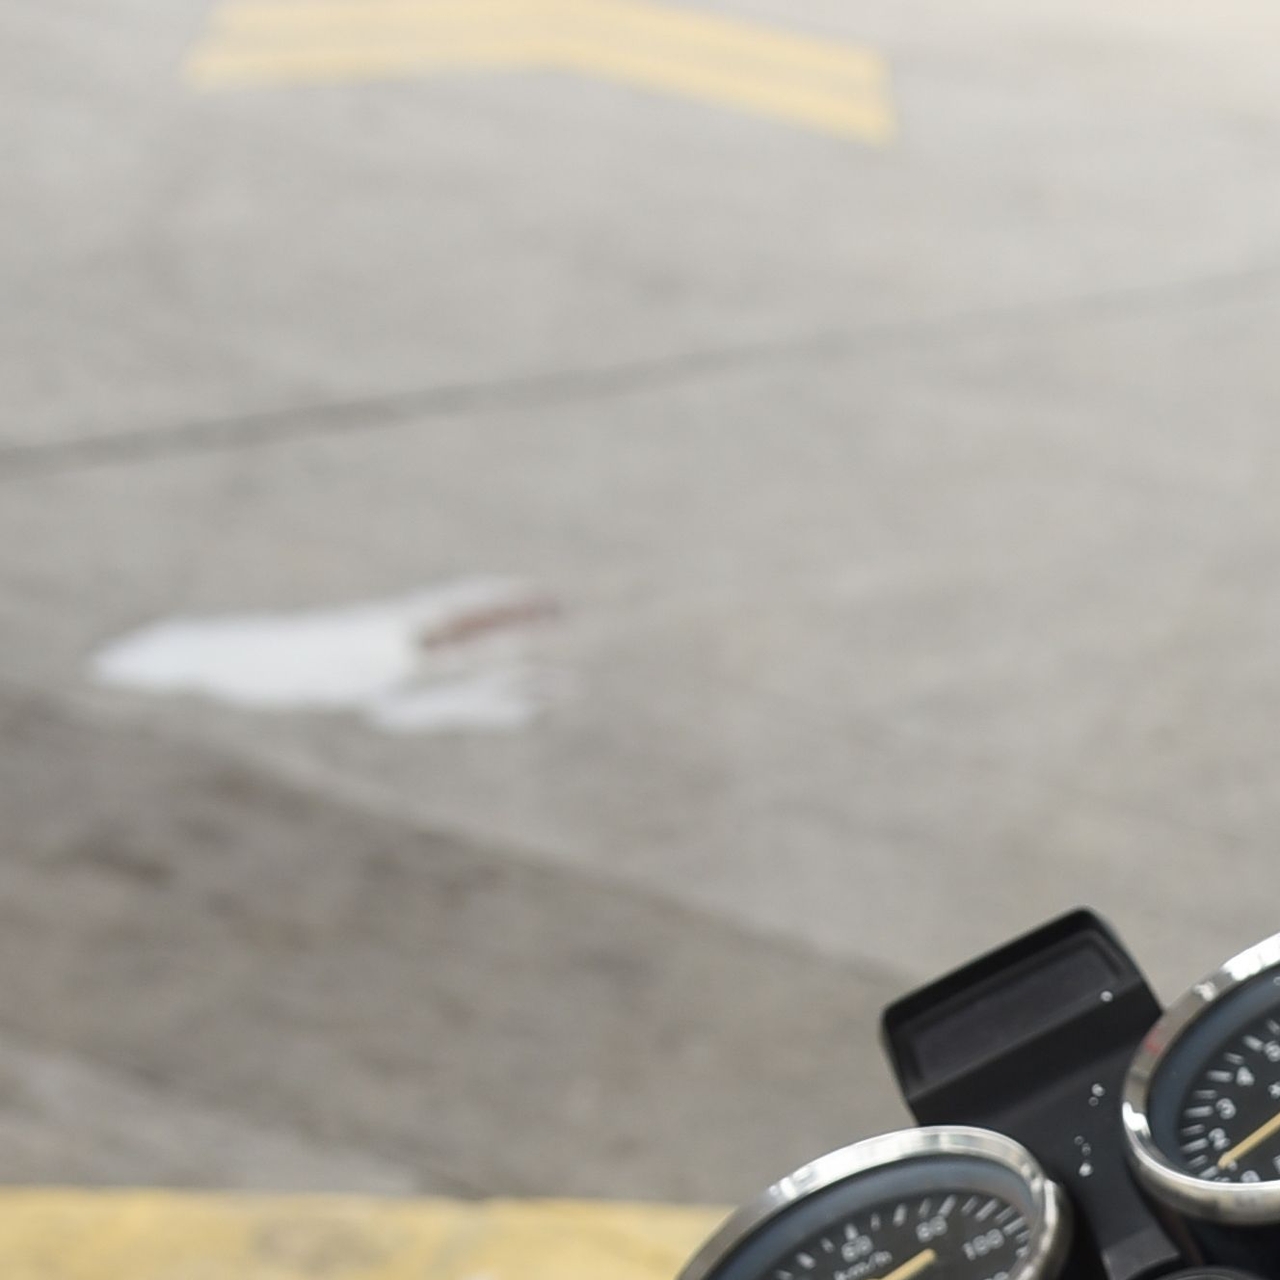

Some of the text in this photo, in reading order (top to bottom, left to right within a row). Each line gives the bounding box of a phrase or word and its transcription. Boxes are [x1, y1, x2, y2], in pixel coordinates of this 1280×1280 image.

[1236, 1066, 1255, 1087] 4
[1216, 1097, 1237, 1120] 3
[1208, 1127, 1231, 1151] 2
[962, 1228, 1005, 1261] 100
